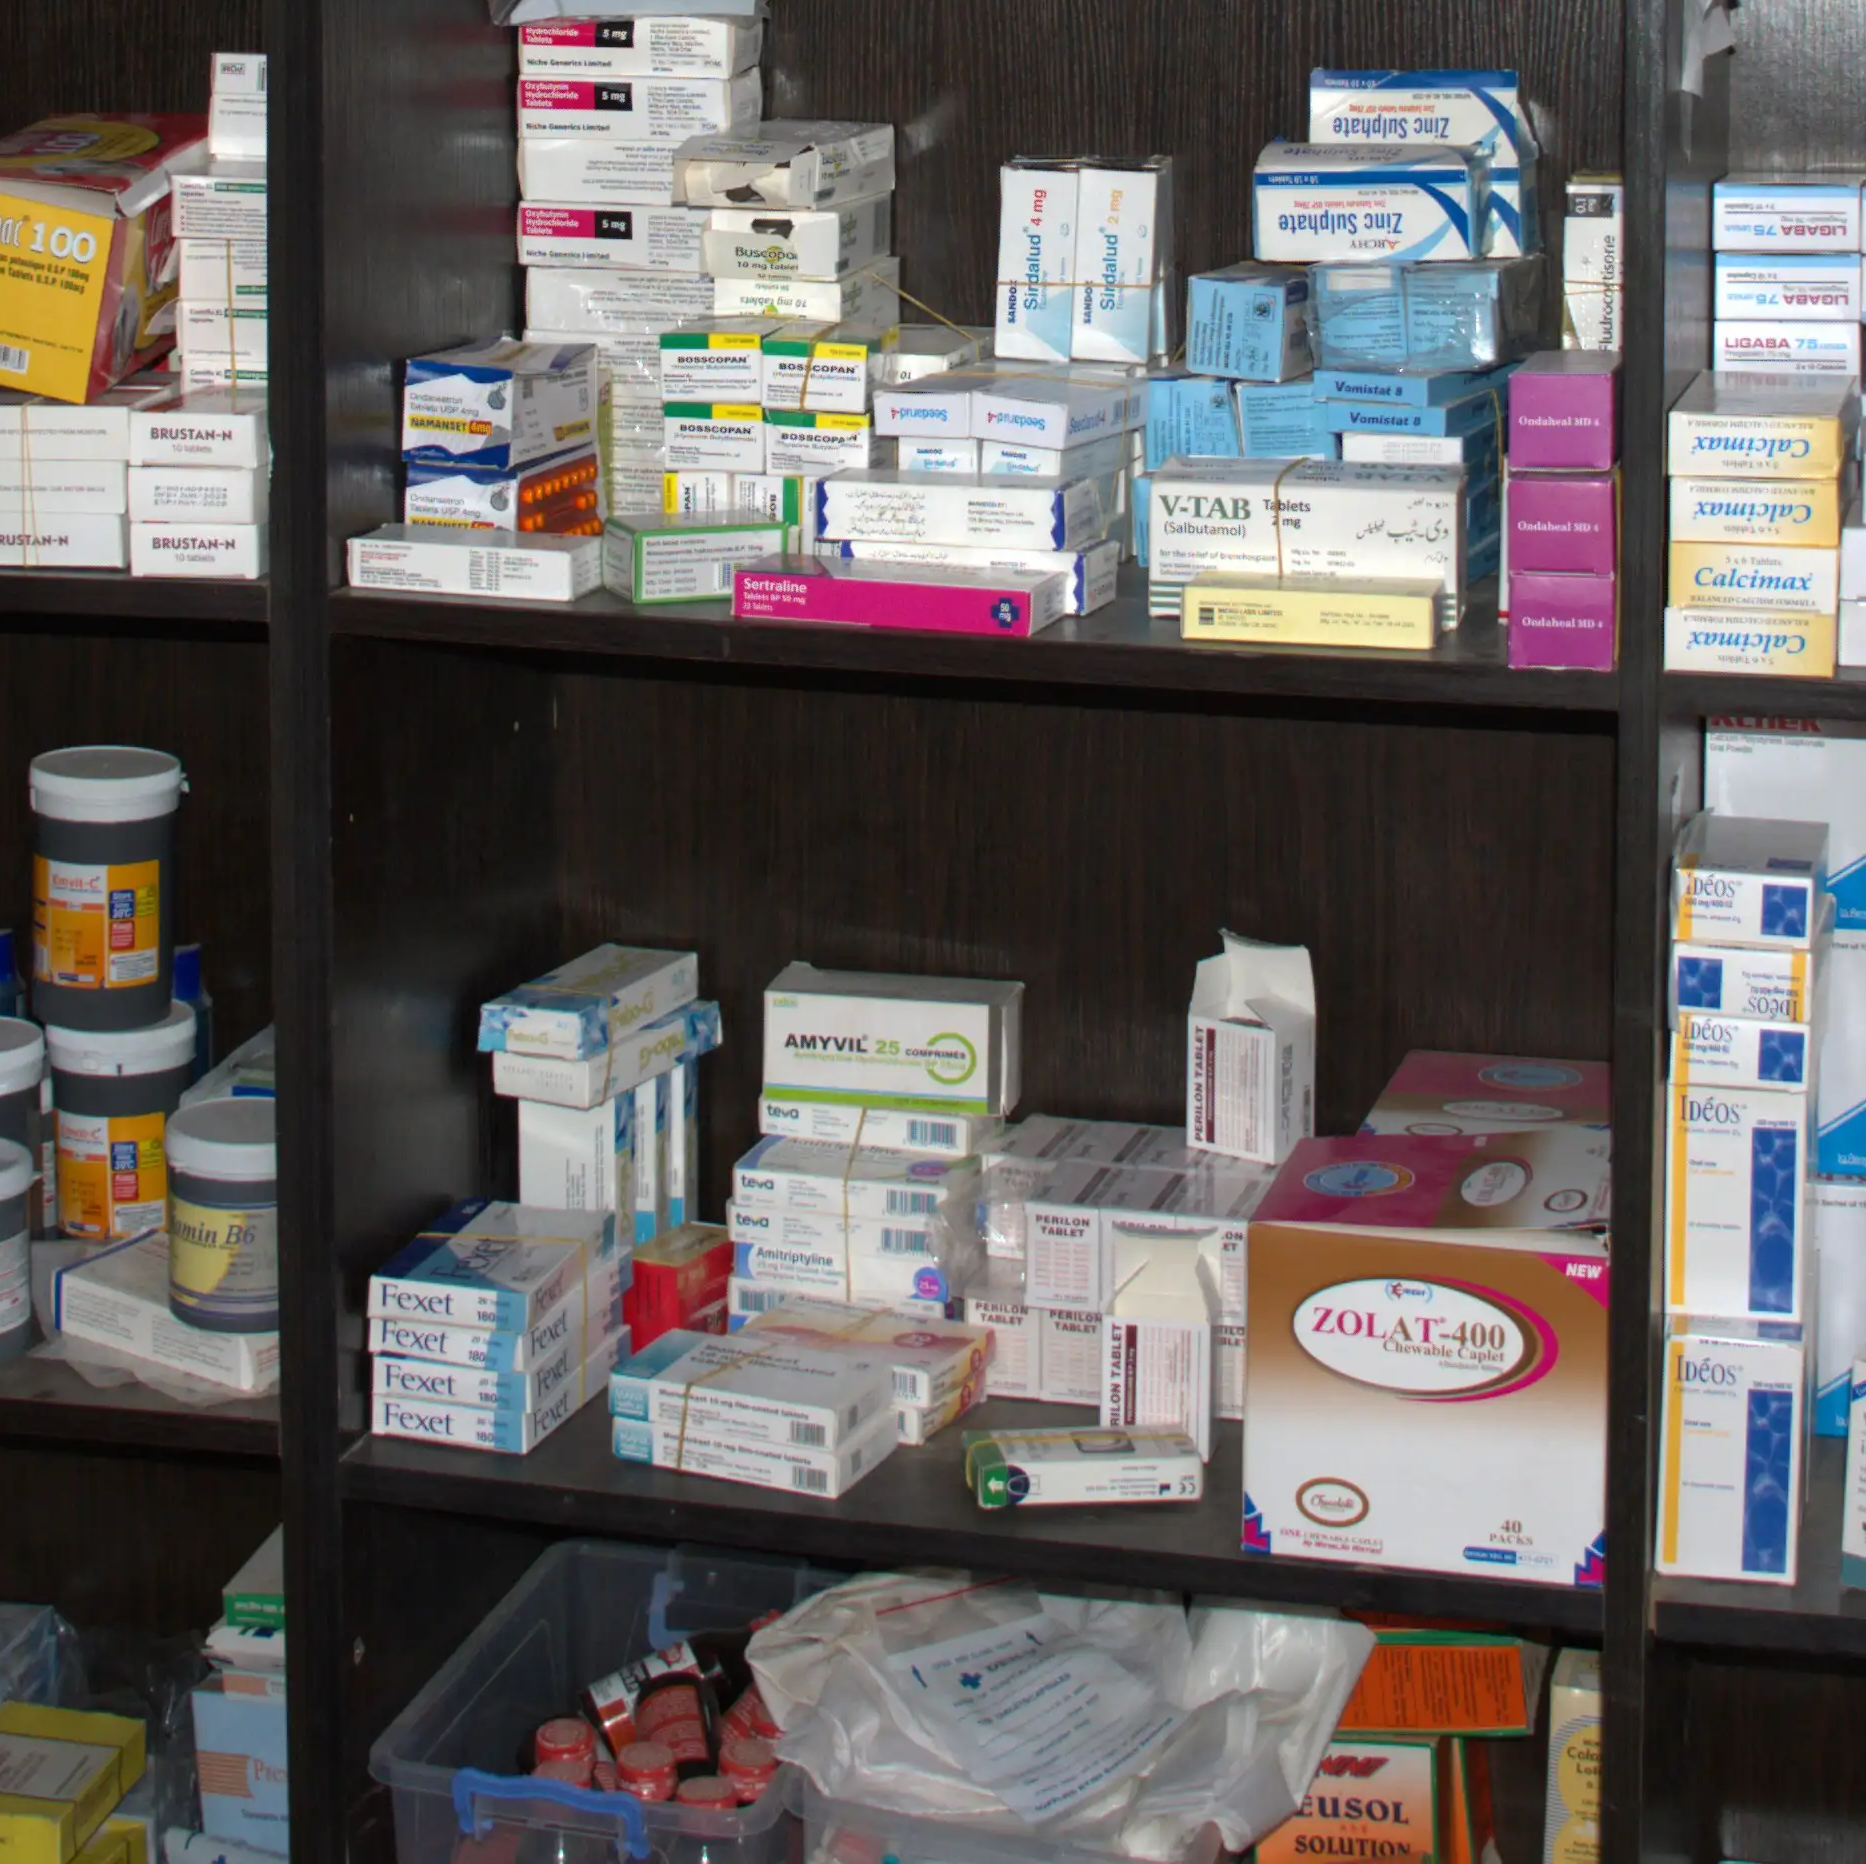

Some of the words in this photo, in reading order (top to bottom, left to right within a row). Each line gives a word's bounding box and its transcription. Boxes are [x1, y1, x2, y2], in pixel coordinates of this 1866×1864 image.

[1333, 117, 1408, 139] Sulphate
[1414, 117, 1450, 138] Zinc
[1034, 189, 1047, 213] mg
[1031, 218, 1042, 226] 4
[31, 222, 97, 263] 100
[1024, 234, 1041, 310] Sirdalud
[677, 356, 749, 364] BOSSCOPAN
[1335, 382, 1389, 394] Vomistat
[411, 417, 465, 432] NAMANSET
[1519, 417, 1571, 427] Ondaheal
[150, 427, 232, 441] BRUSTAN-N
[1159, 496, 1251, 521] V-TAB
[1163, 523, 1246, 539] (Salbutamol)
[744, 578, 807, 594] Sertraline
[1694, 567, 1813, 592] Calcimax
[785, 1034, 865, 1052] AMYVIL
[875, 1038, 899, 1055] 25
[741, 1175, 774, 1191] teva
[1036, 1215, 1089, 1228] PERILON
[1040, 1225, 1084, 1237] TABLET
[756, 1246, 834, 1267] Amitriptyline
[1566, 1264, 1601, 1278] NEW
[380, 1283, 454, 1316] Fexet
[1312, 1307, 1505, 1348] ZOLAT-400
[1382, 1340, 1452, 1358] Chewable
[1457, 1347, 1504, 1363] Caplet
[1501, 1520, 1521, 1534] 40
[1488, 1534, 1533, 1545] PACKS
[1294, 1835, 1411, 1858] SOLUTION
